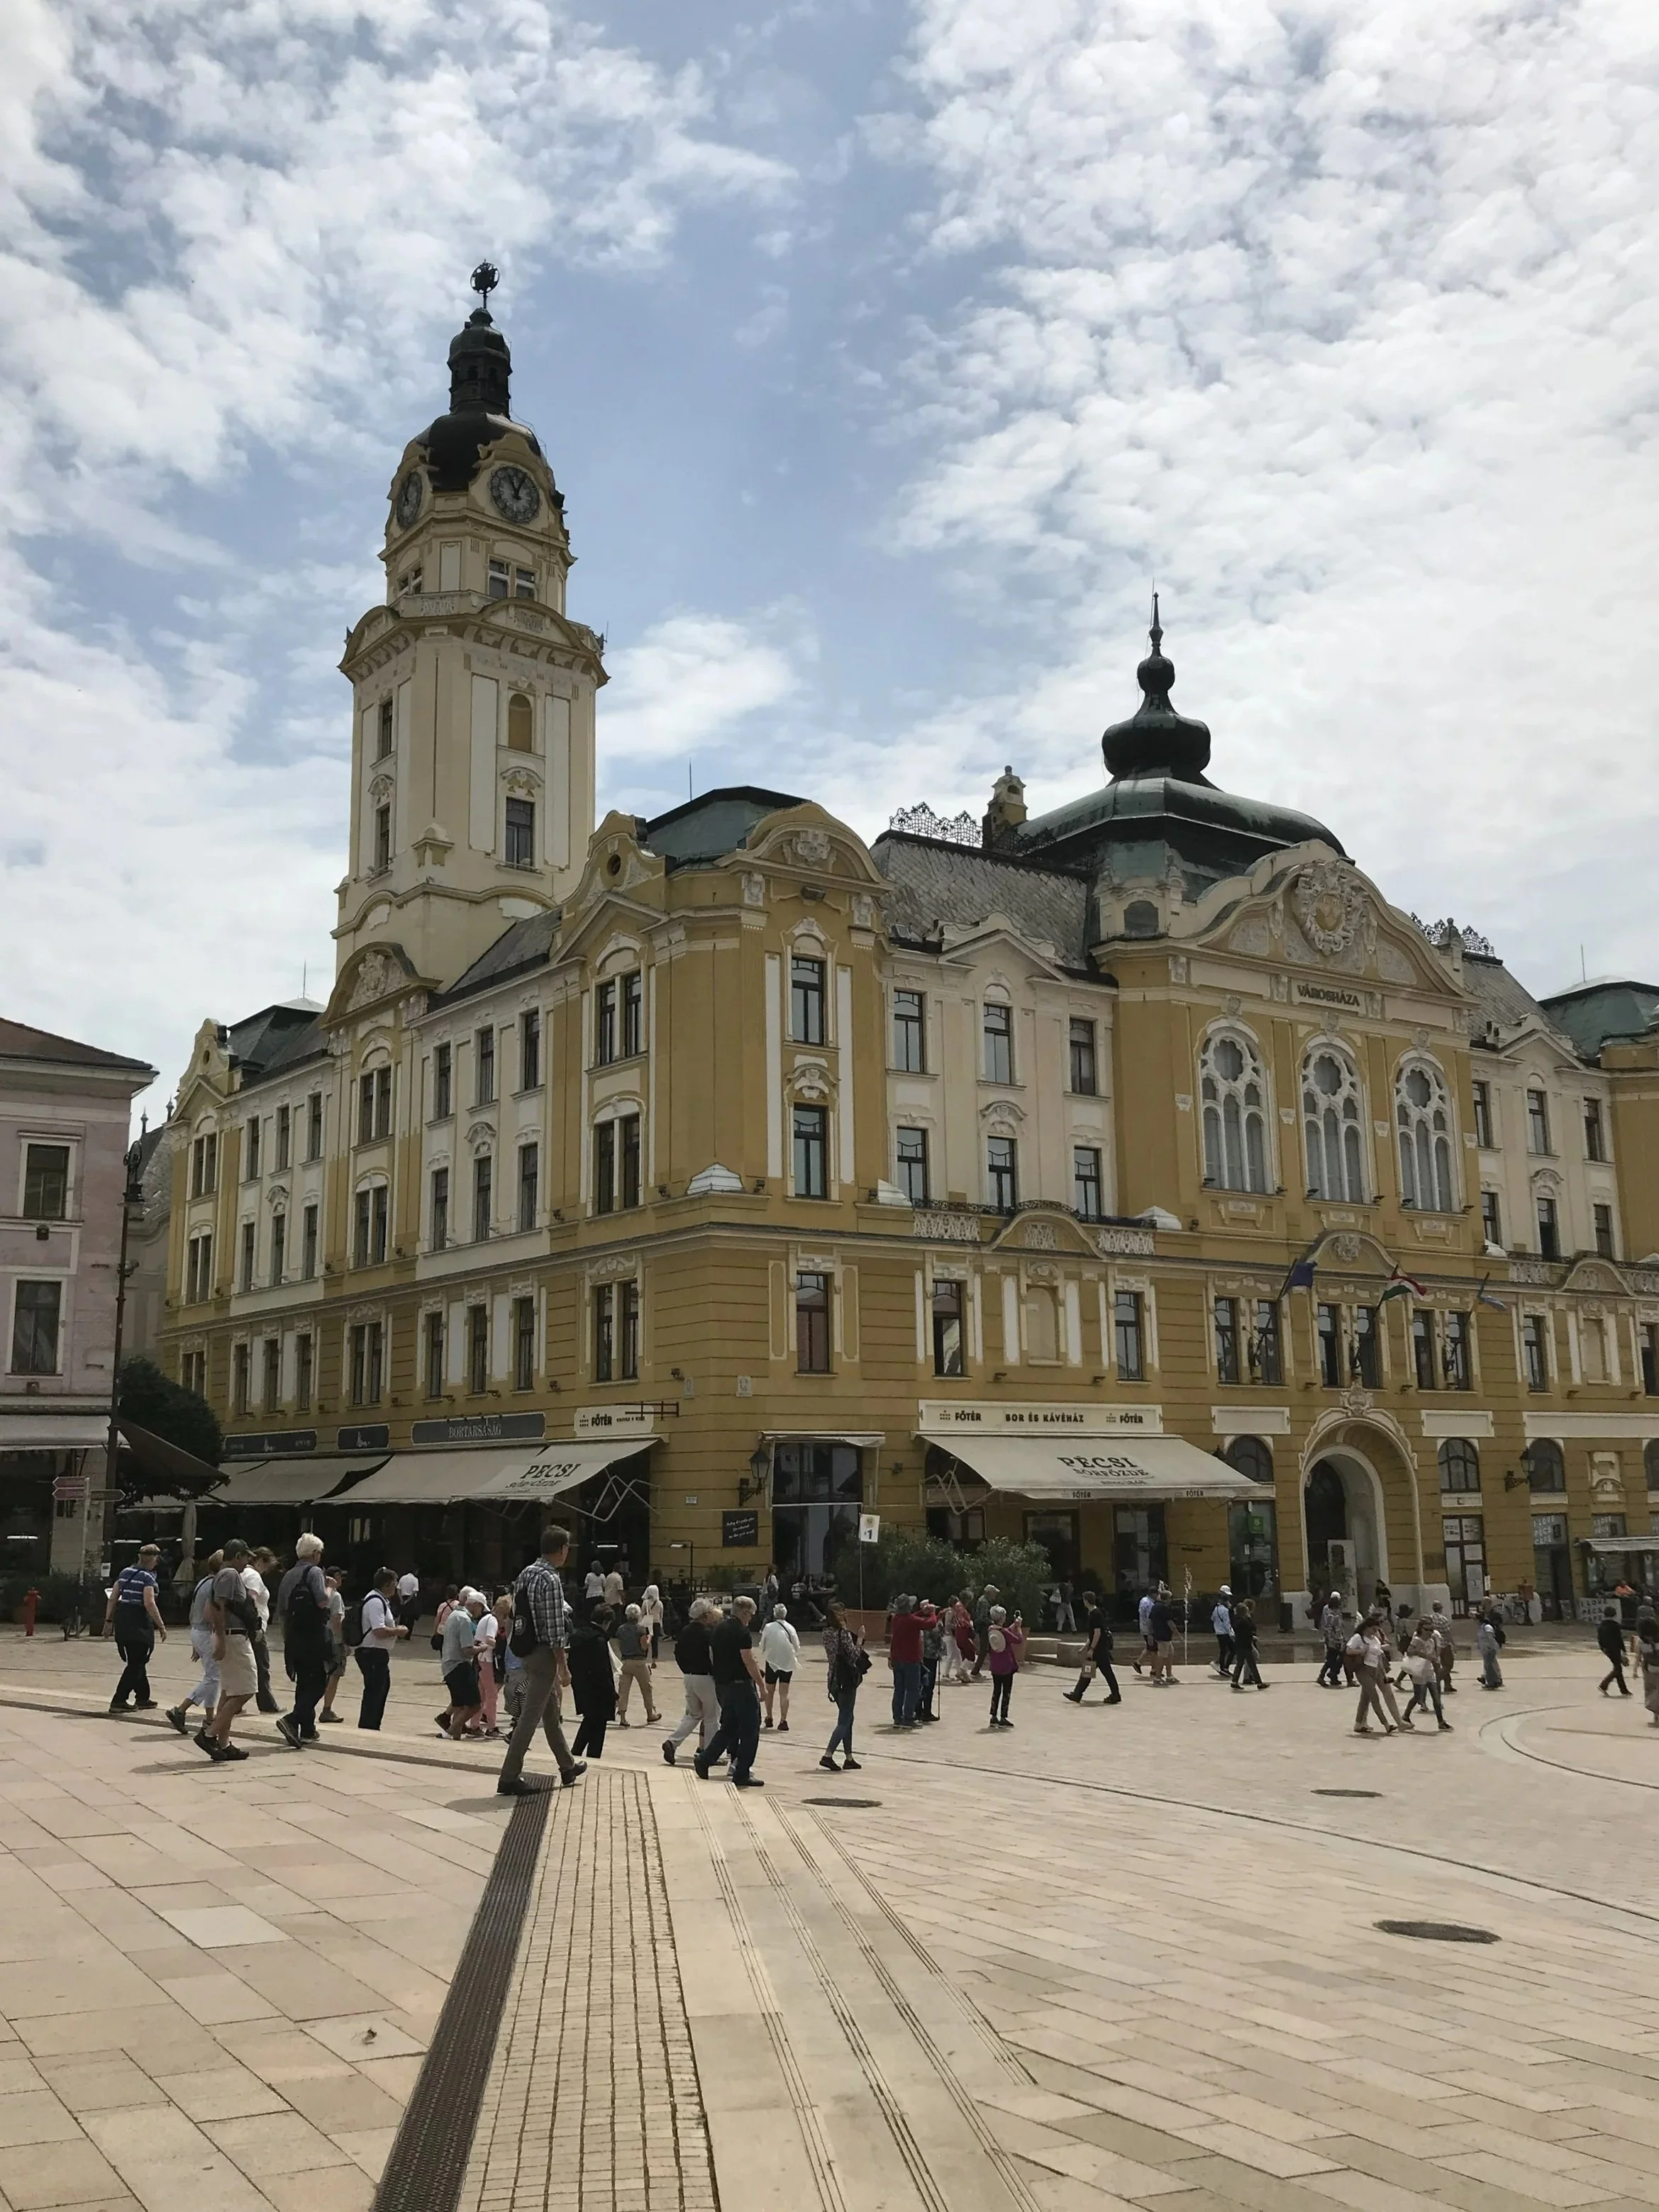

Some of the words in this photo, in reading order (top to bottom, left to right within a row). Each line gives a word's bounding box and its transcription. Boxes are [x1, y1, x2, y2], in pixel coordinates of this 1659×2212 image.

[1297, 983, 1360, 1006] VÁROSHÁZA
[1005, 1413, 1024, 1422] BOR
[1028, 1411, 1039, 1423] ÉS
[1043, 1412, 1084, 1423] KÁVÉHÁZ
